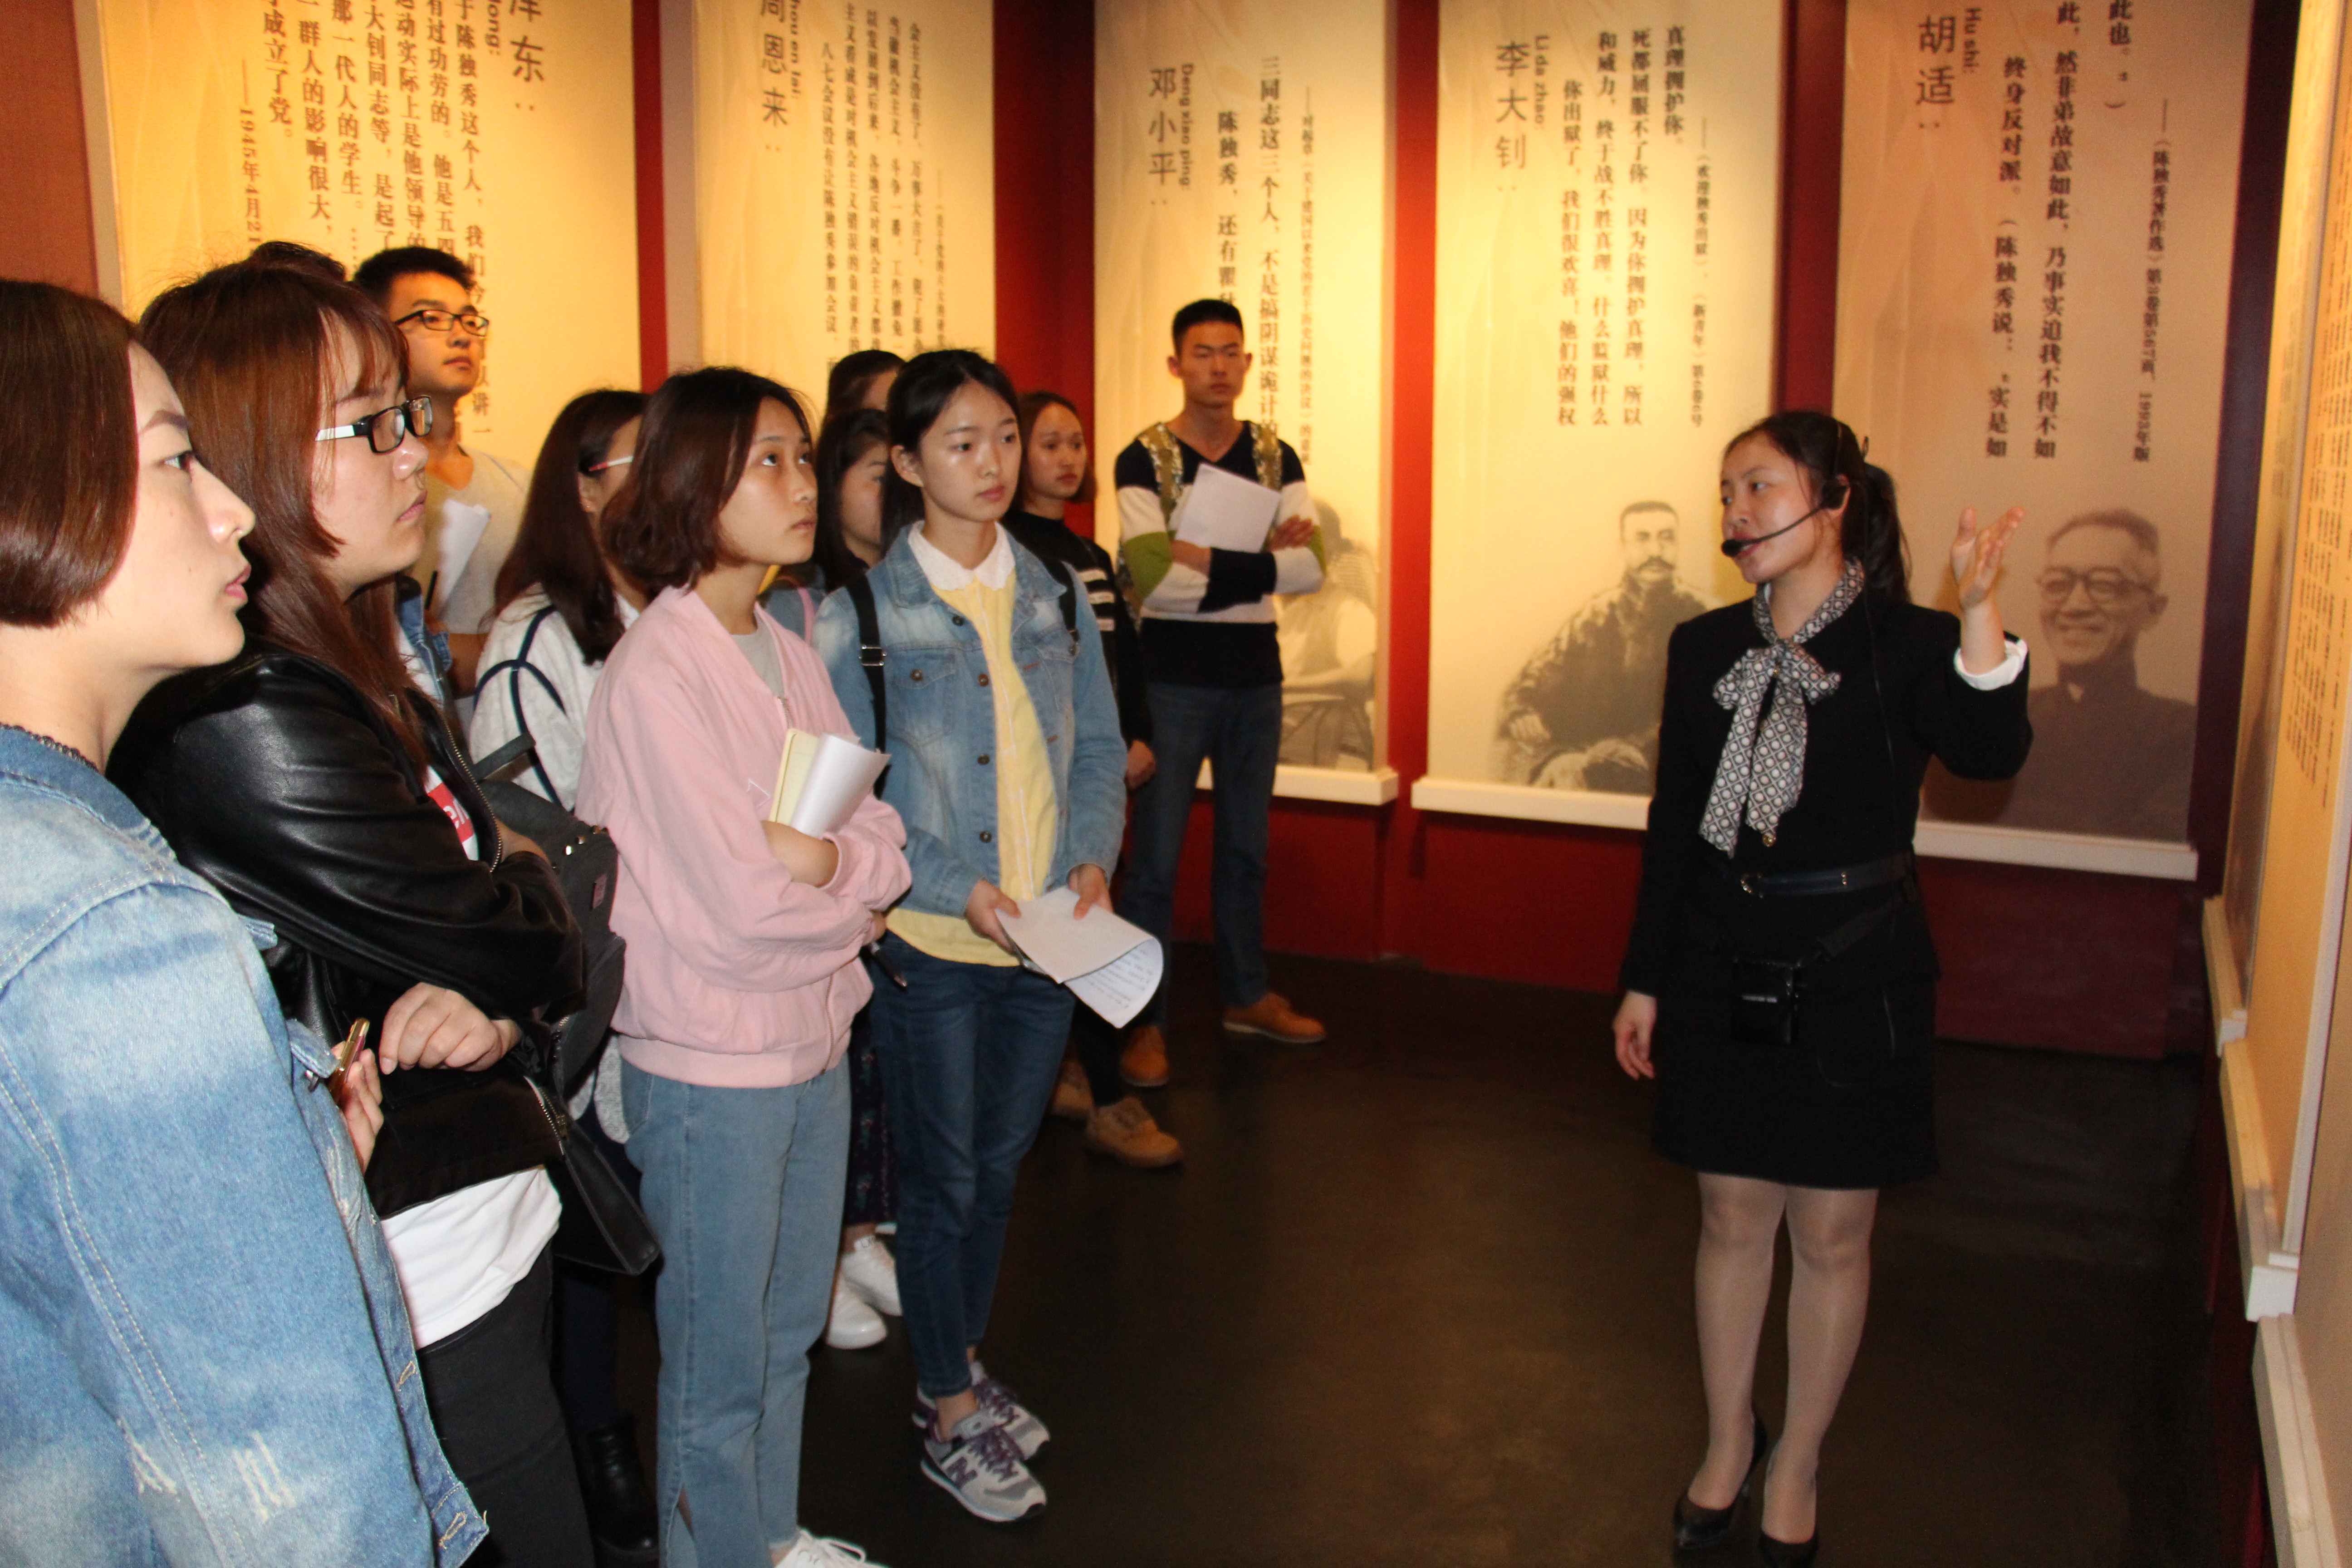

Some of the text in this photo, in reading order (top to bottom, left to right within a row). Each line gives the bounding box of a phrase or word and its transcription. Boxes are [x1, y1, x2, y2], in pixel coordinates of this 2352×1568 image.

[263, 0, 292, 137] 成立了党。
[1916, 15, 1956, 129] 胡适：
